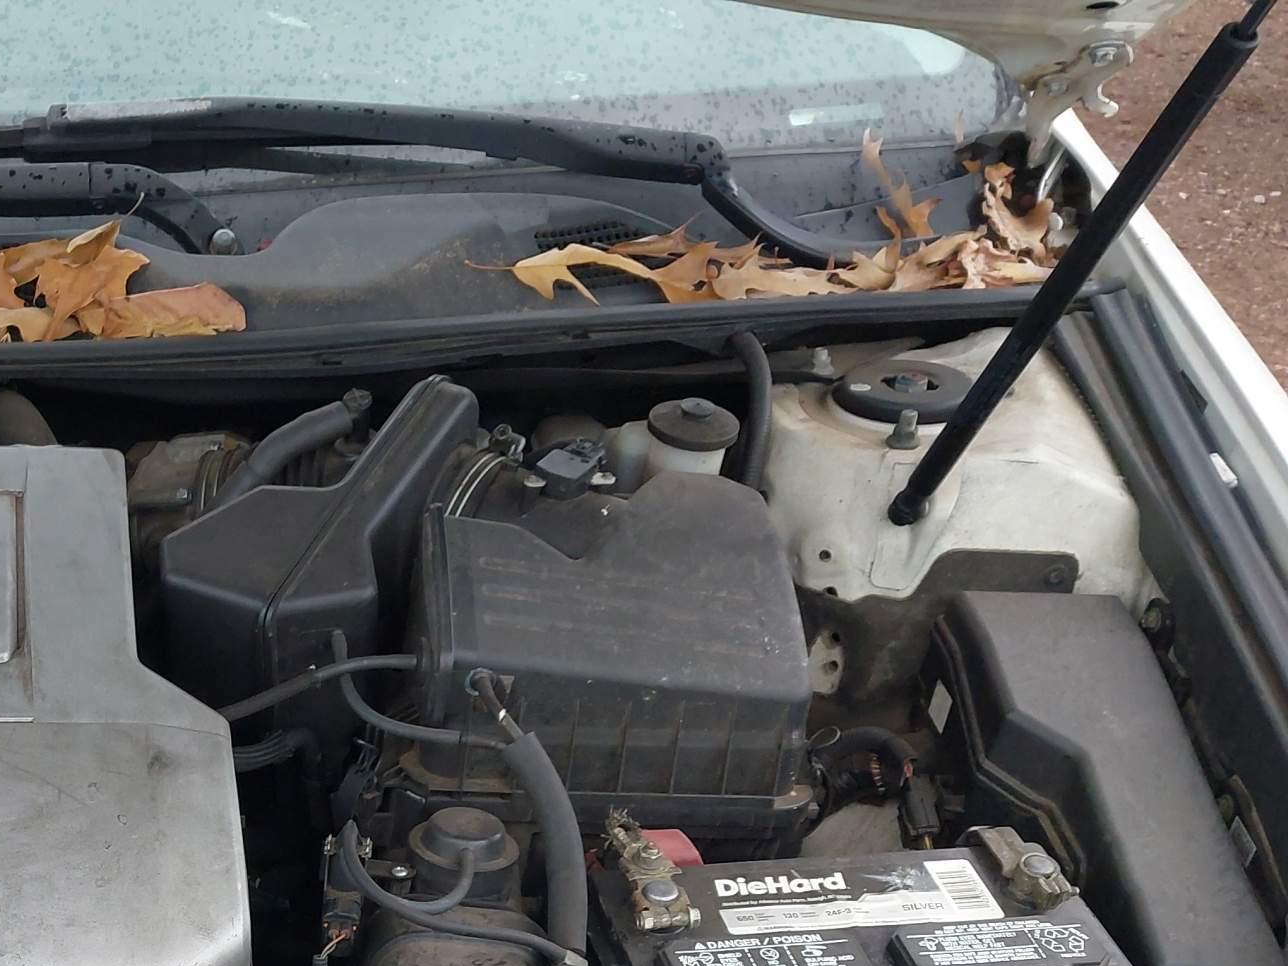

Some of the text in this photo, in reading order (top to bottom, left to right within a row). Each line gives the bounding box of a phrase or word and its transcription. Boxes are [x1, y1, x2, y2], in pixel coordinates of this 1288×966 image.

[713, 871, 848, 897] DieHard
[902, 902, 945, 912] SILVER
[706, 938, 761, 950] DANGER
[774, 934, 823, 944] POISON
